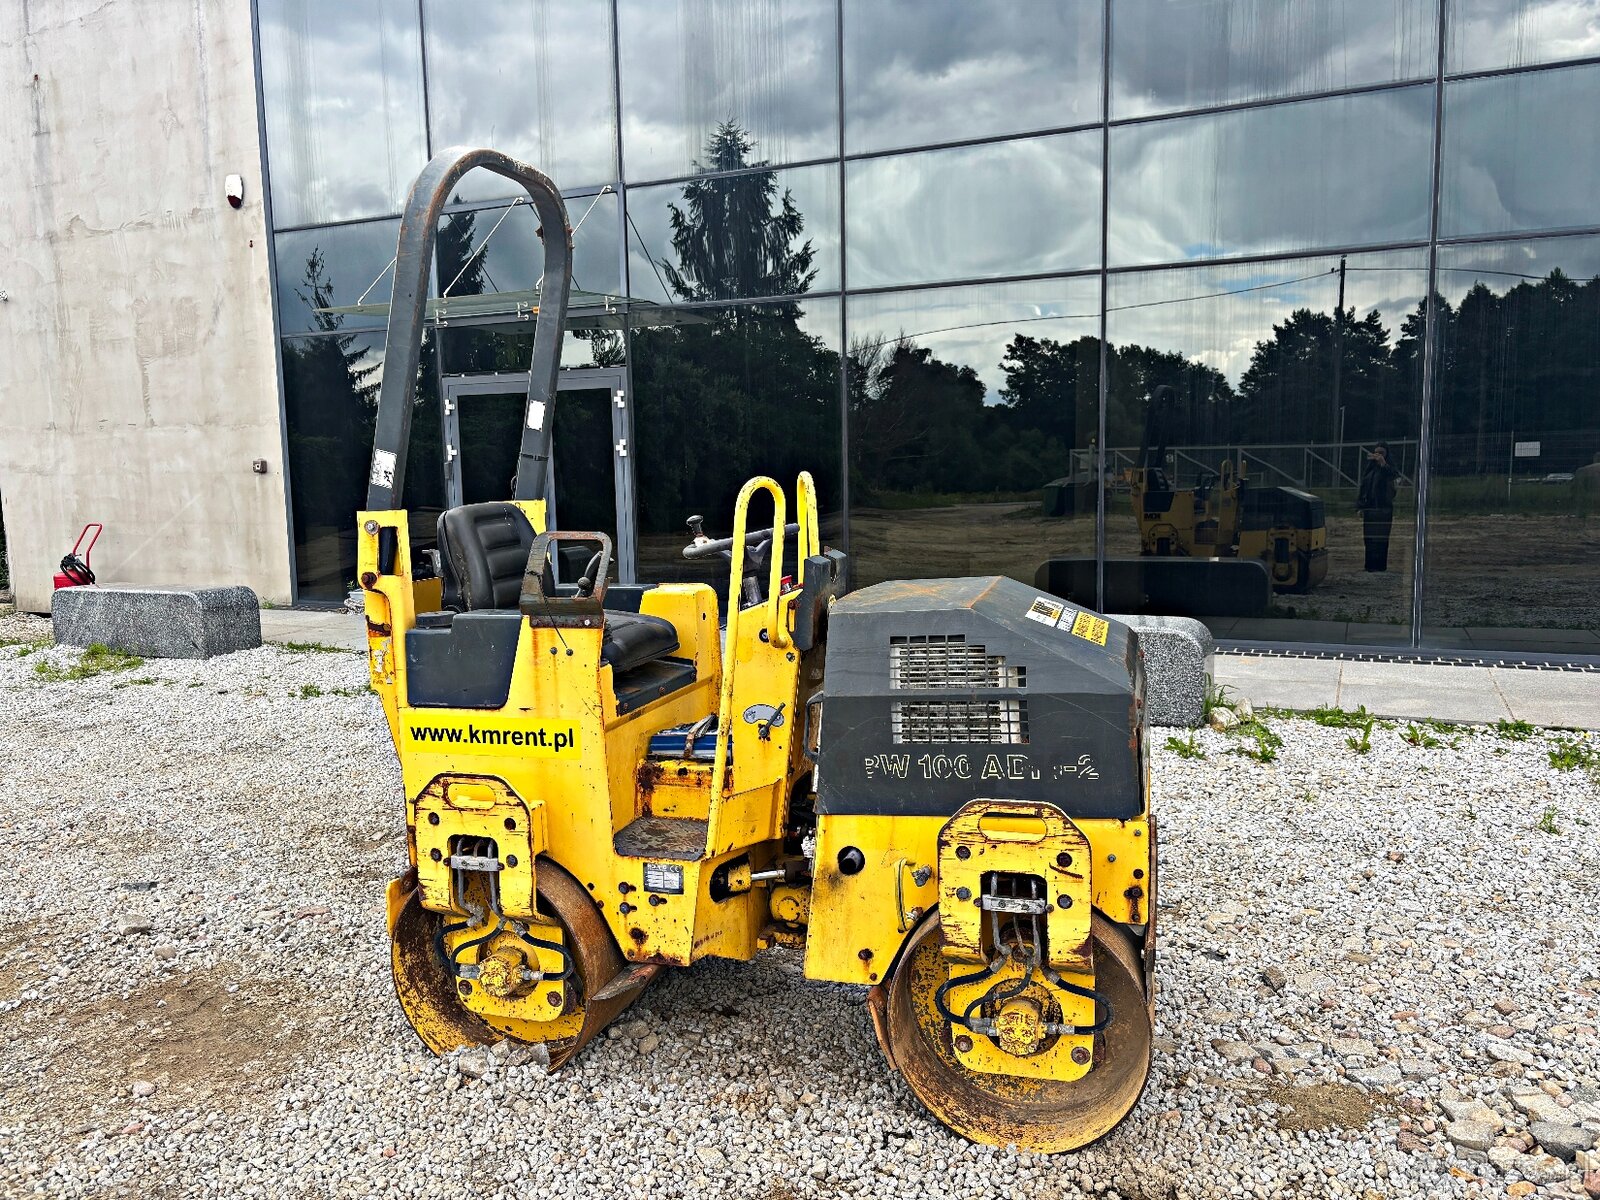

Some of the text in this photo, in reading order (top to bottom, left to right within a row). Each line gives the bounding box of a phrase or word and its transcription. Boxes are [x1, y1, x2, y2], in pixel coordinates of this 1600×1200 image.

[410, 724, 574, 752] www.kmrent.pl
[917, 753, 972, 779] 100
[980, 754, 1100, 780] AD-2
